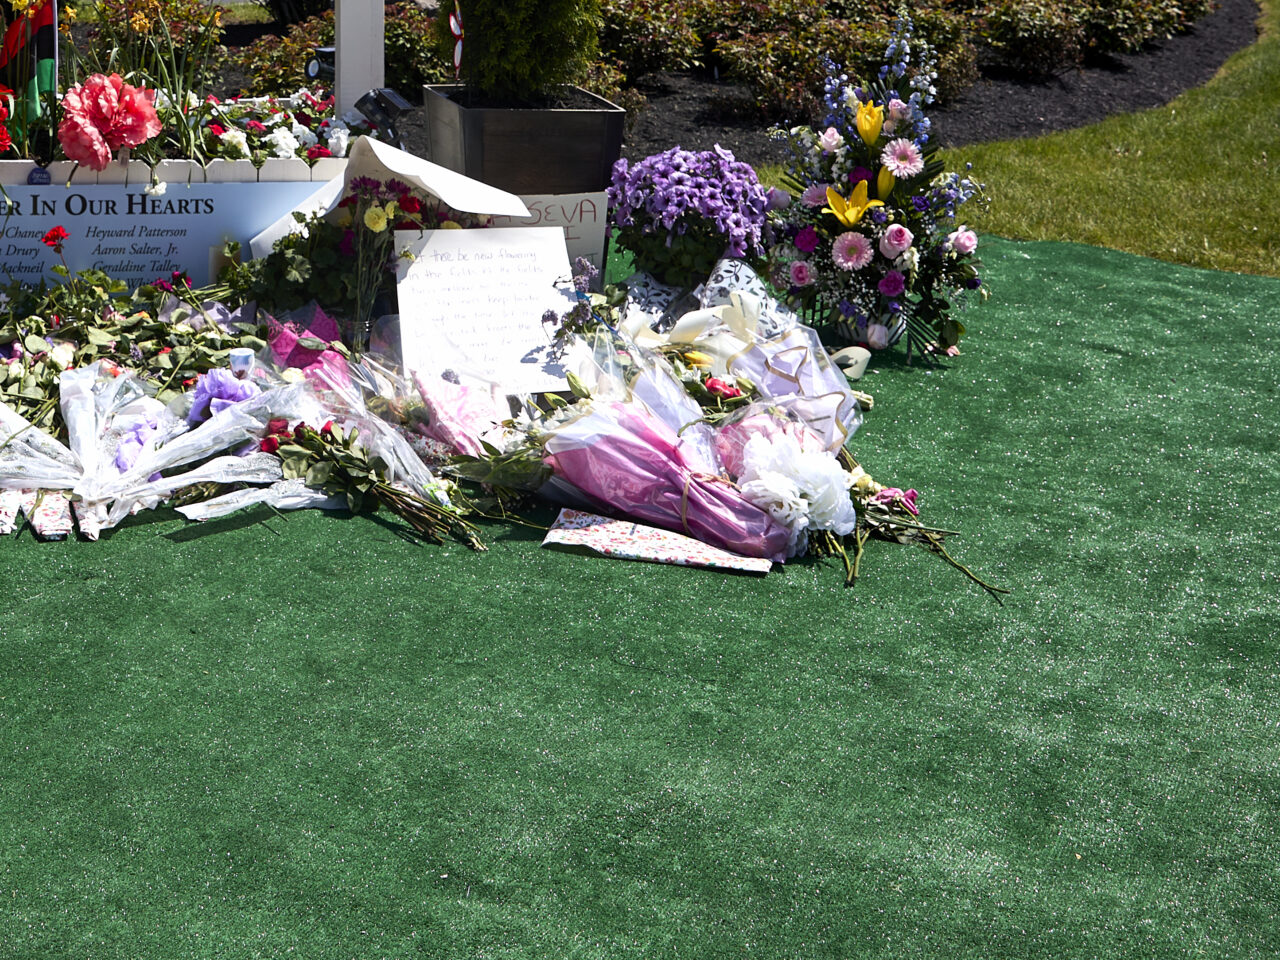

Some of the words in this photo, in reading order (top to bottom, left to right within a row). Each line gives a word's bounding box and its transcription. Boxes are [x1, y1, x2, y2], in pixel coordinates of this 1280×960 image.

[520, 199, 597, 225] SEVA
[5, 226, 46, 242] Chaney
[85, 225, 136, 240] Heyward
[138, 225, 187, 238] Patterson
[5, 244, 40, 260] Drury
[91, 243, 126, 256] Aaron
[164, 242, 179, 257] Jr.
[92, 259, 146, 273] Geraldine
[150, 259, 181, 274] Talley
